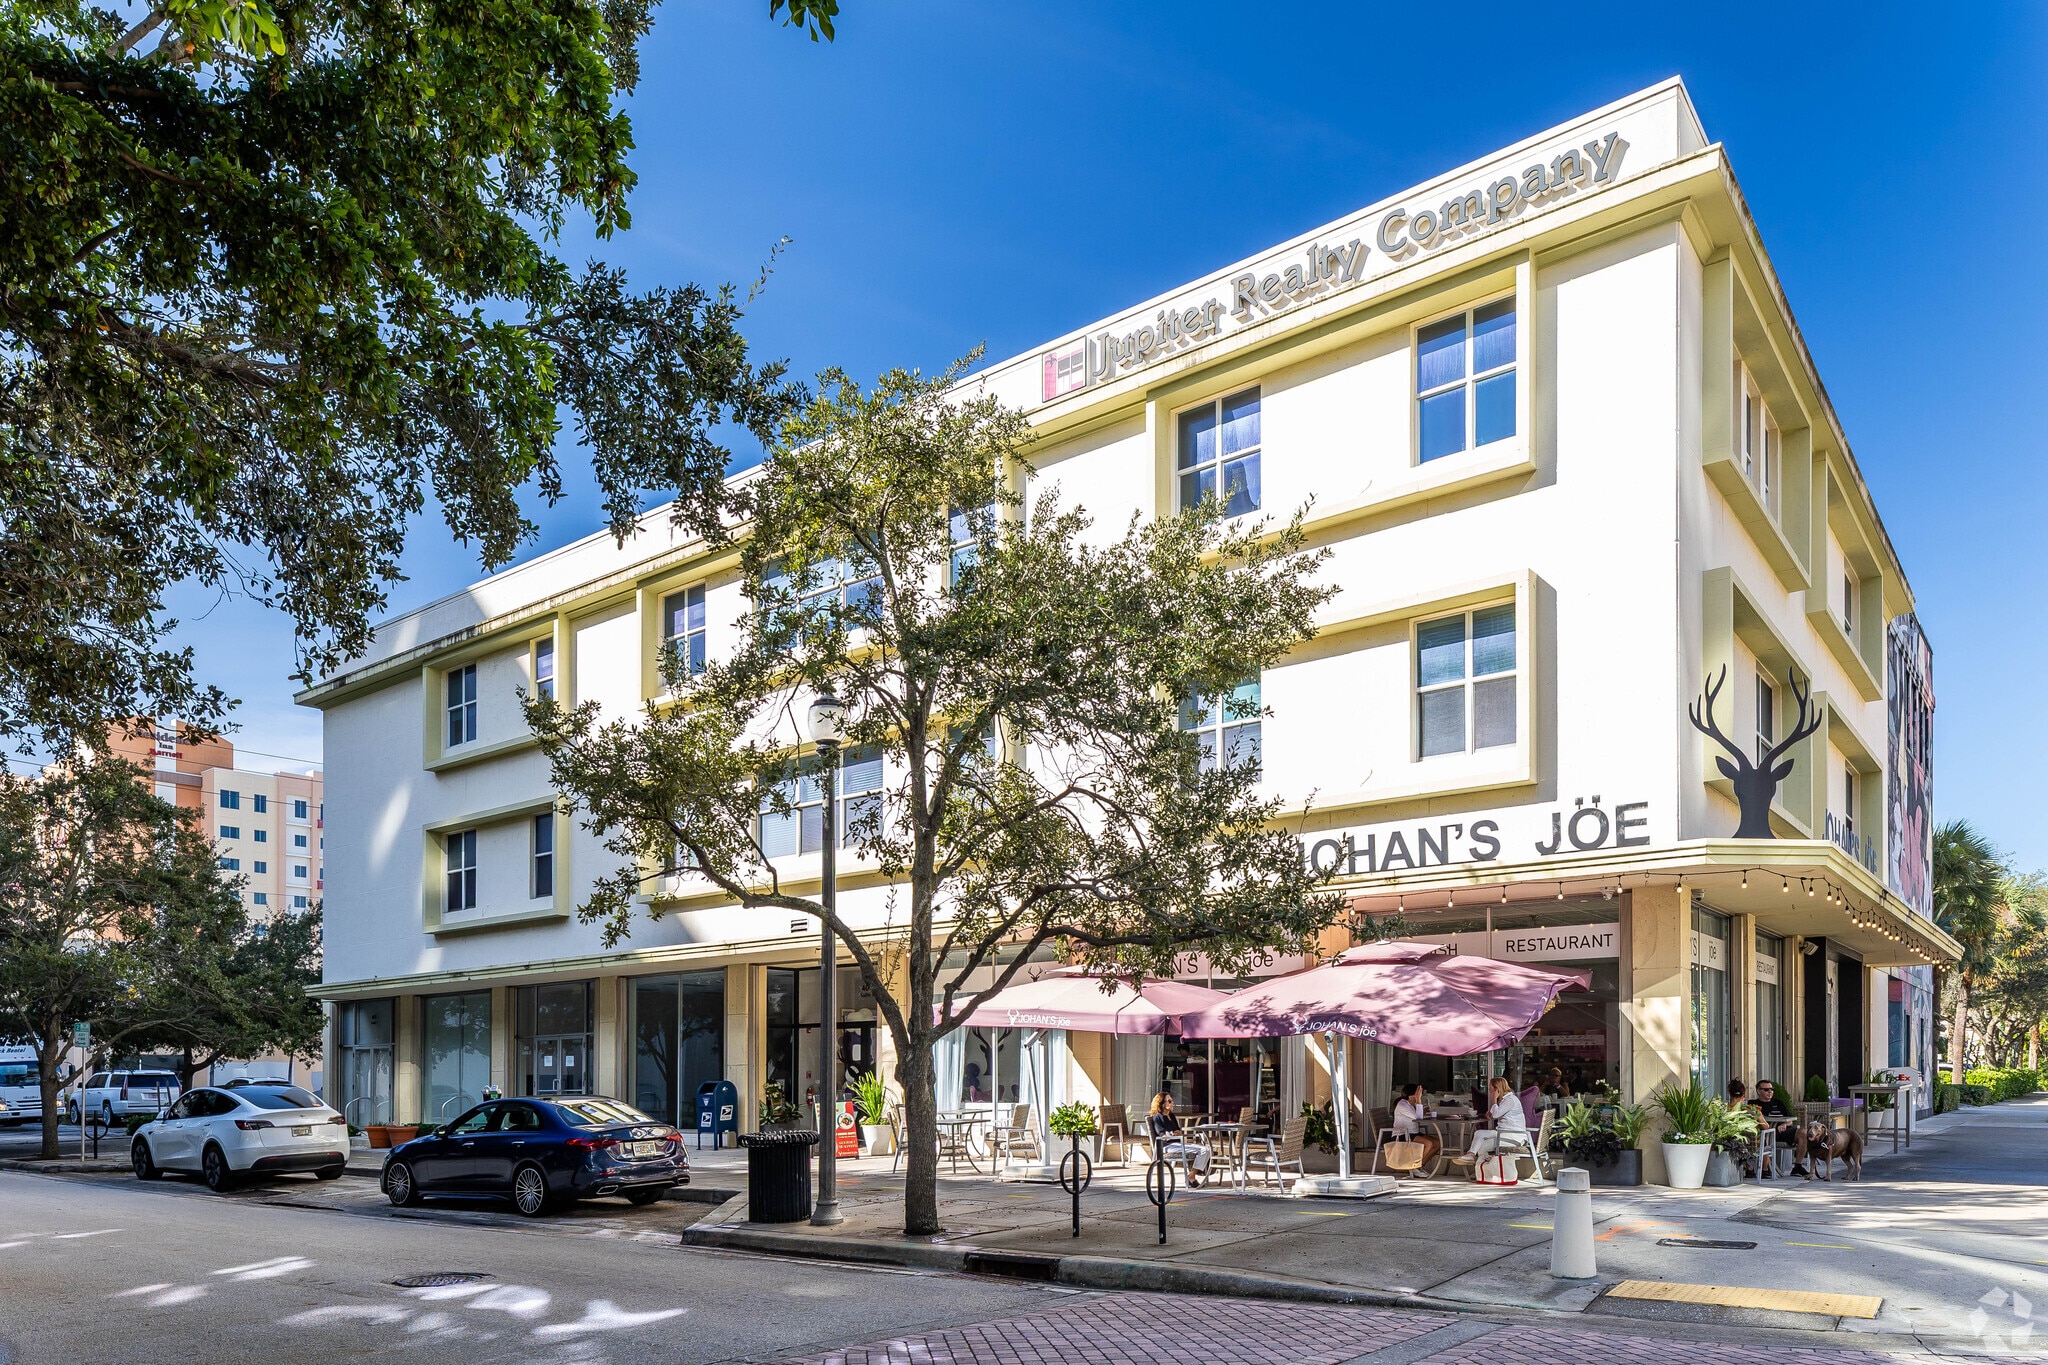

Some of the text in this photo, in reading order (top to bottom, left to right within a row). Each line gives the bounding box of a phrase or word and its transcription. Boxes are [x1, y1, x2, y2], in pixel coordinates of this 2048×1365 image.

[1092, 131, 1622, 379] Jupiter Realty Company
[149, 748, 183, 759] Marriott
[1535, 794, 1651, 855] JÖE
[1505, 933, 1613, 953] RESTAURANT
[1018, 1014, 1056, 1025] JOHAN'S
[1306, 1021, 1378, 1038] JOHAN'S jöe
